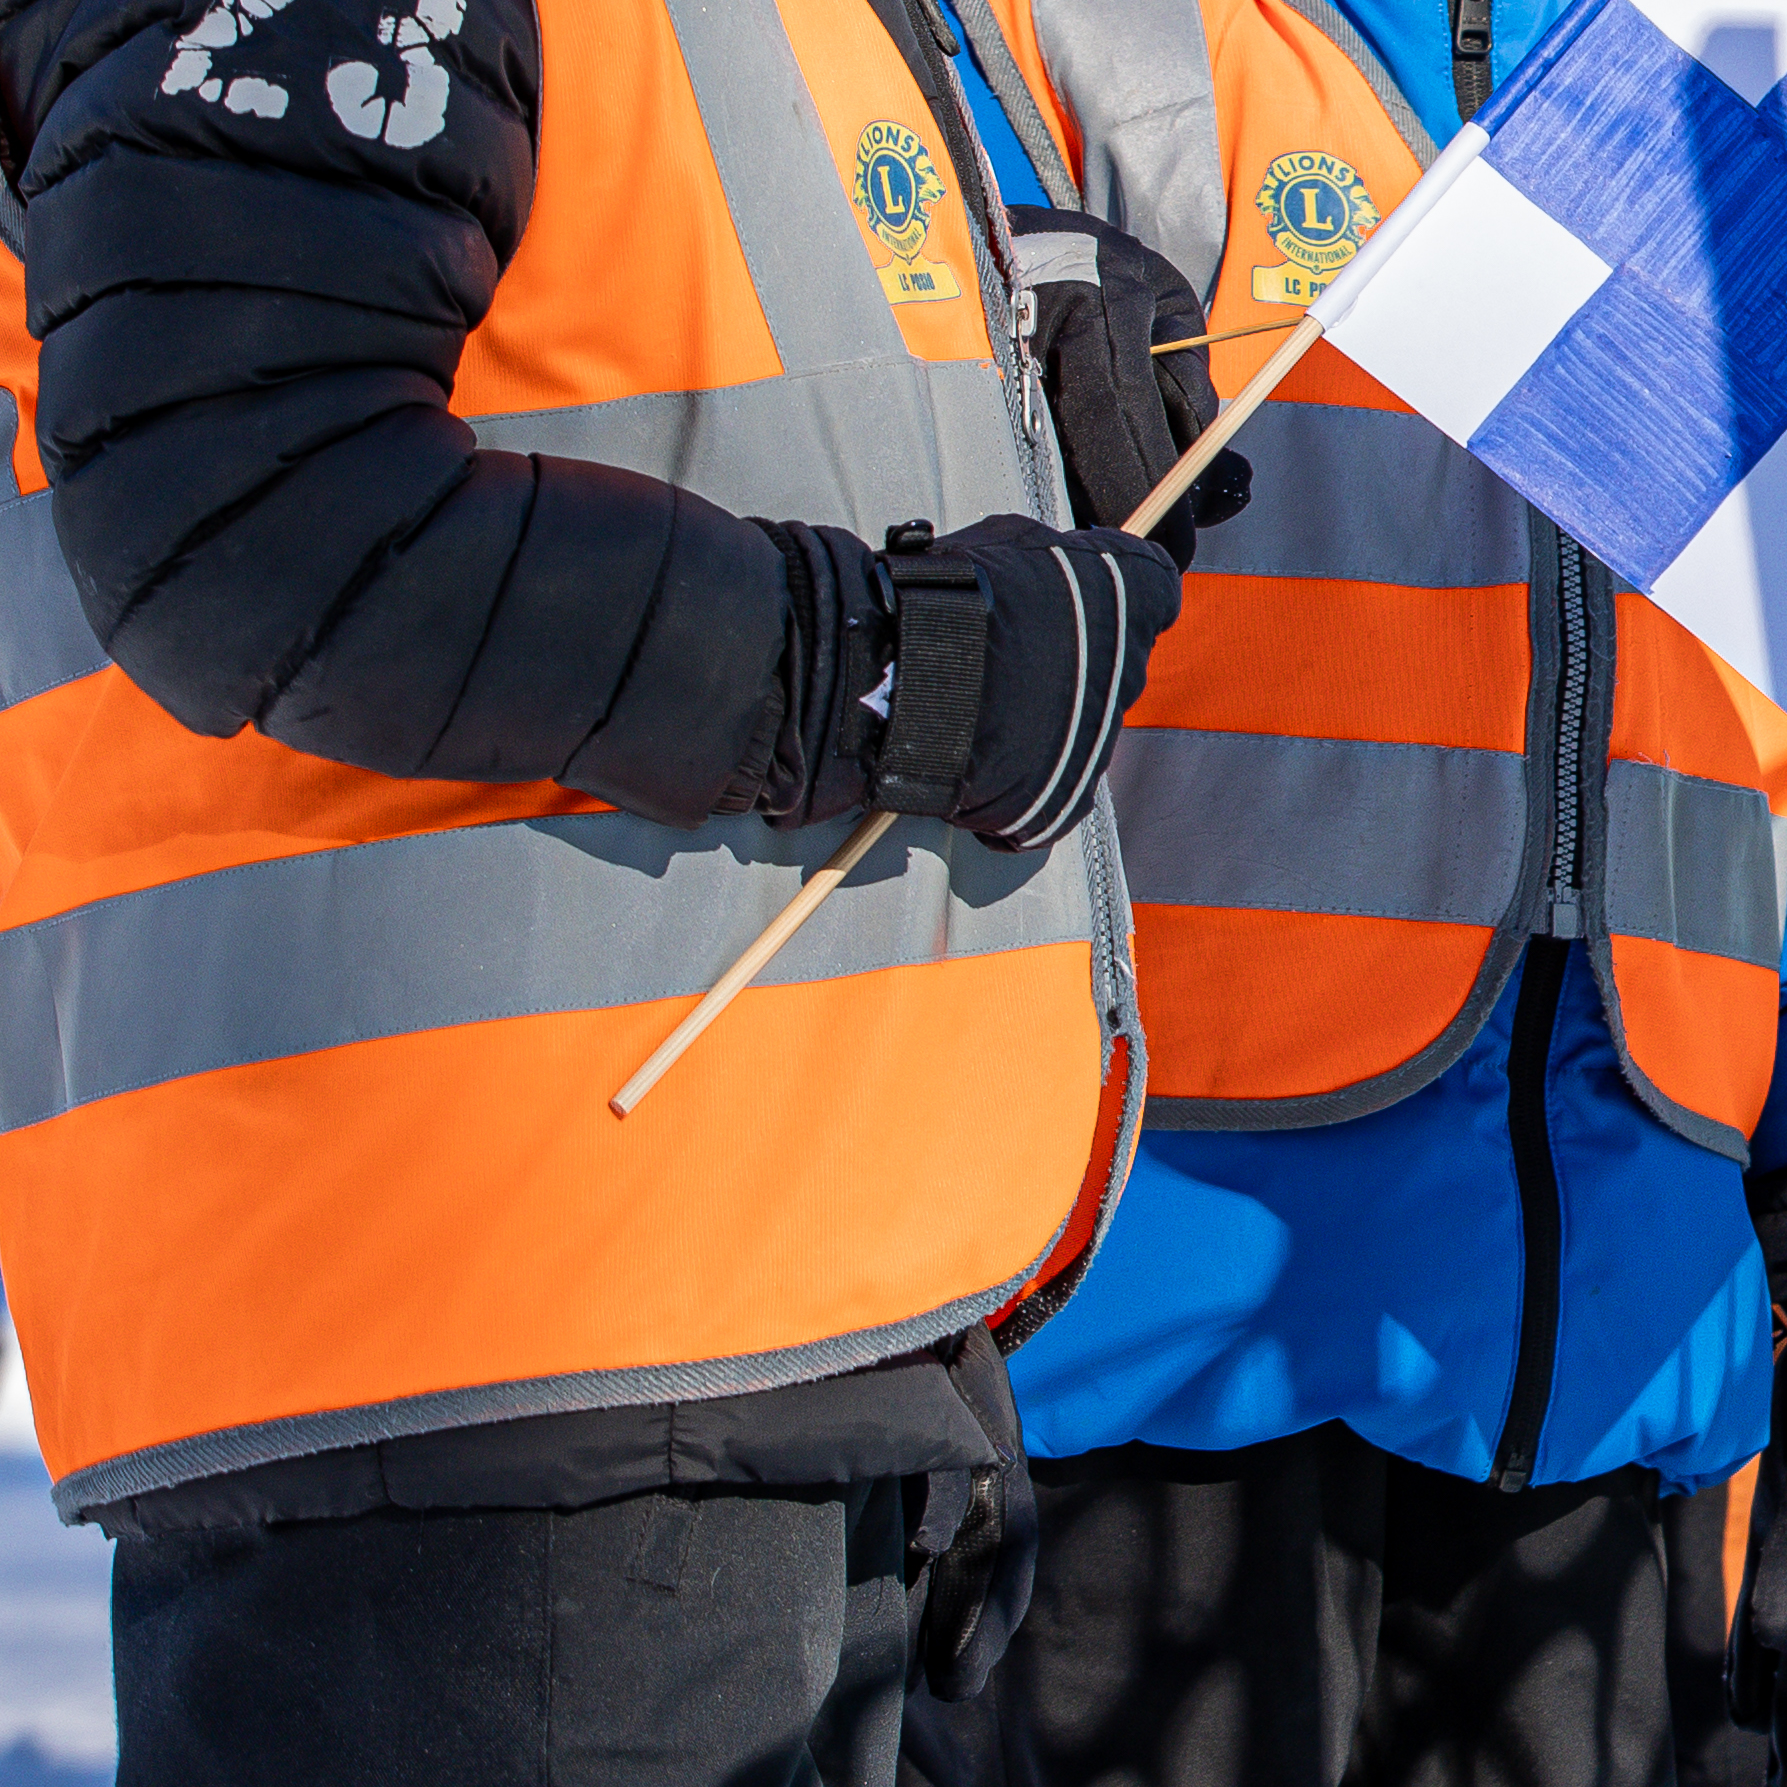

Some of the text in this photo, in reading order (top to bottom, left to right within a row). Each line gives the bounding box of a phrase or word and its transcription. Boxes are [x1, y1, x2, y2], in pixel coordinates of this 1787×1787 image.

[860, 126, 914, 155] LIONS
[1276, 155, 1350, 183] LIONS
[878, 166, 905, 214] L
[1300, 188, 1334, 231] L
[881, 227, 923, 253] INTERNATIONAL
[1281, 236, 1353, 264] INTERNATIONAL
[1285, 277, 1301, 295] LC
